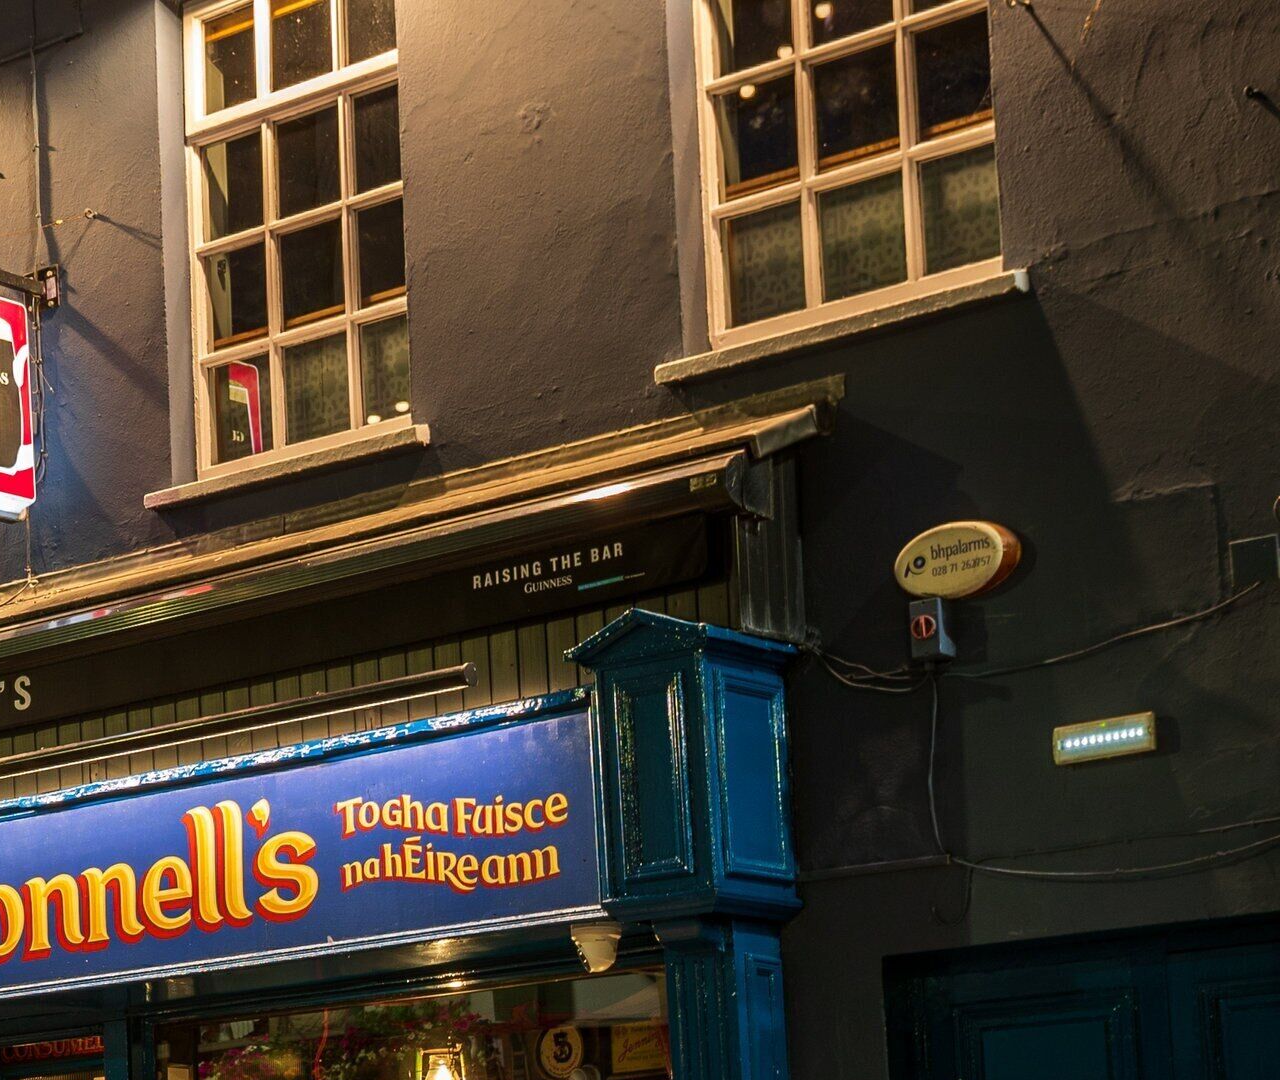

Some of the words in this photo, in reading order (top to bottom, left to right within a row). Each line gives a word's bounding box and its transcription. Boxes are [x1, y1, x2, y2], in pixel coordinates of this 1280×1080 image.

[472, 561, 542, 590] RAISING
[549, 552, 582, 571] THE
[590, 542, 624, 563] BAR
[523, 575, 573, 594] GUINNESS
[552, 1031, 573, 1063] 5
